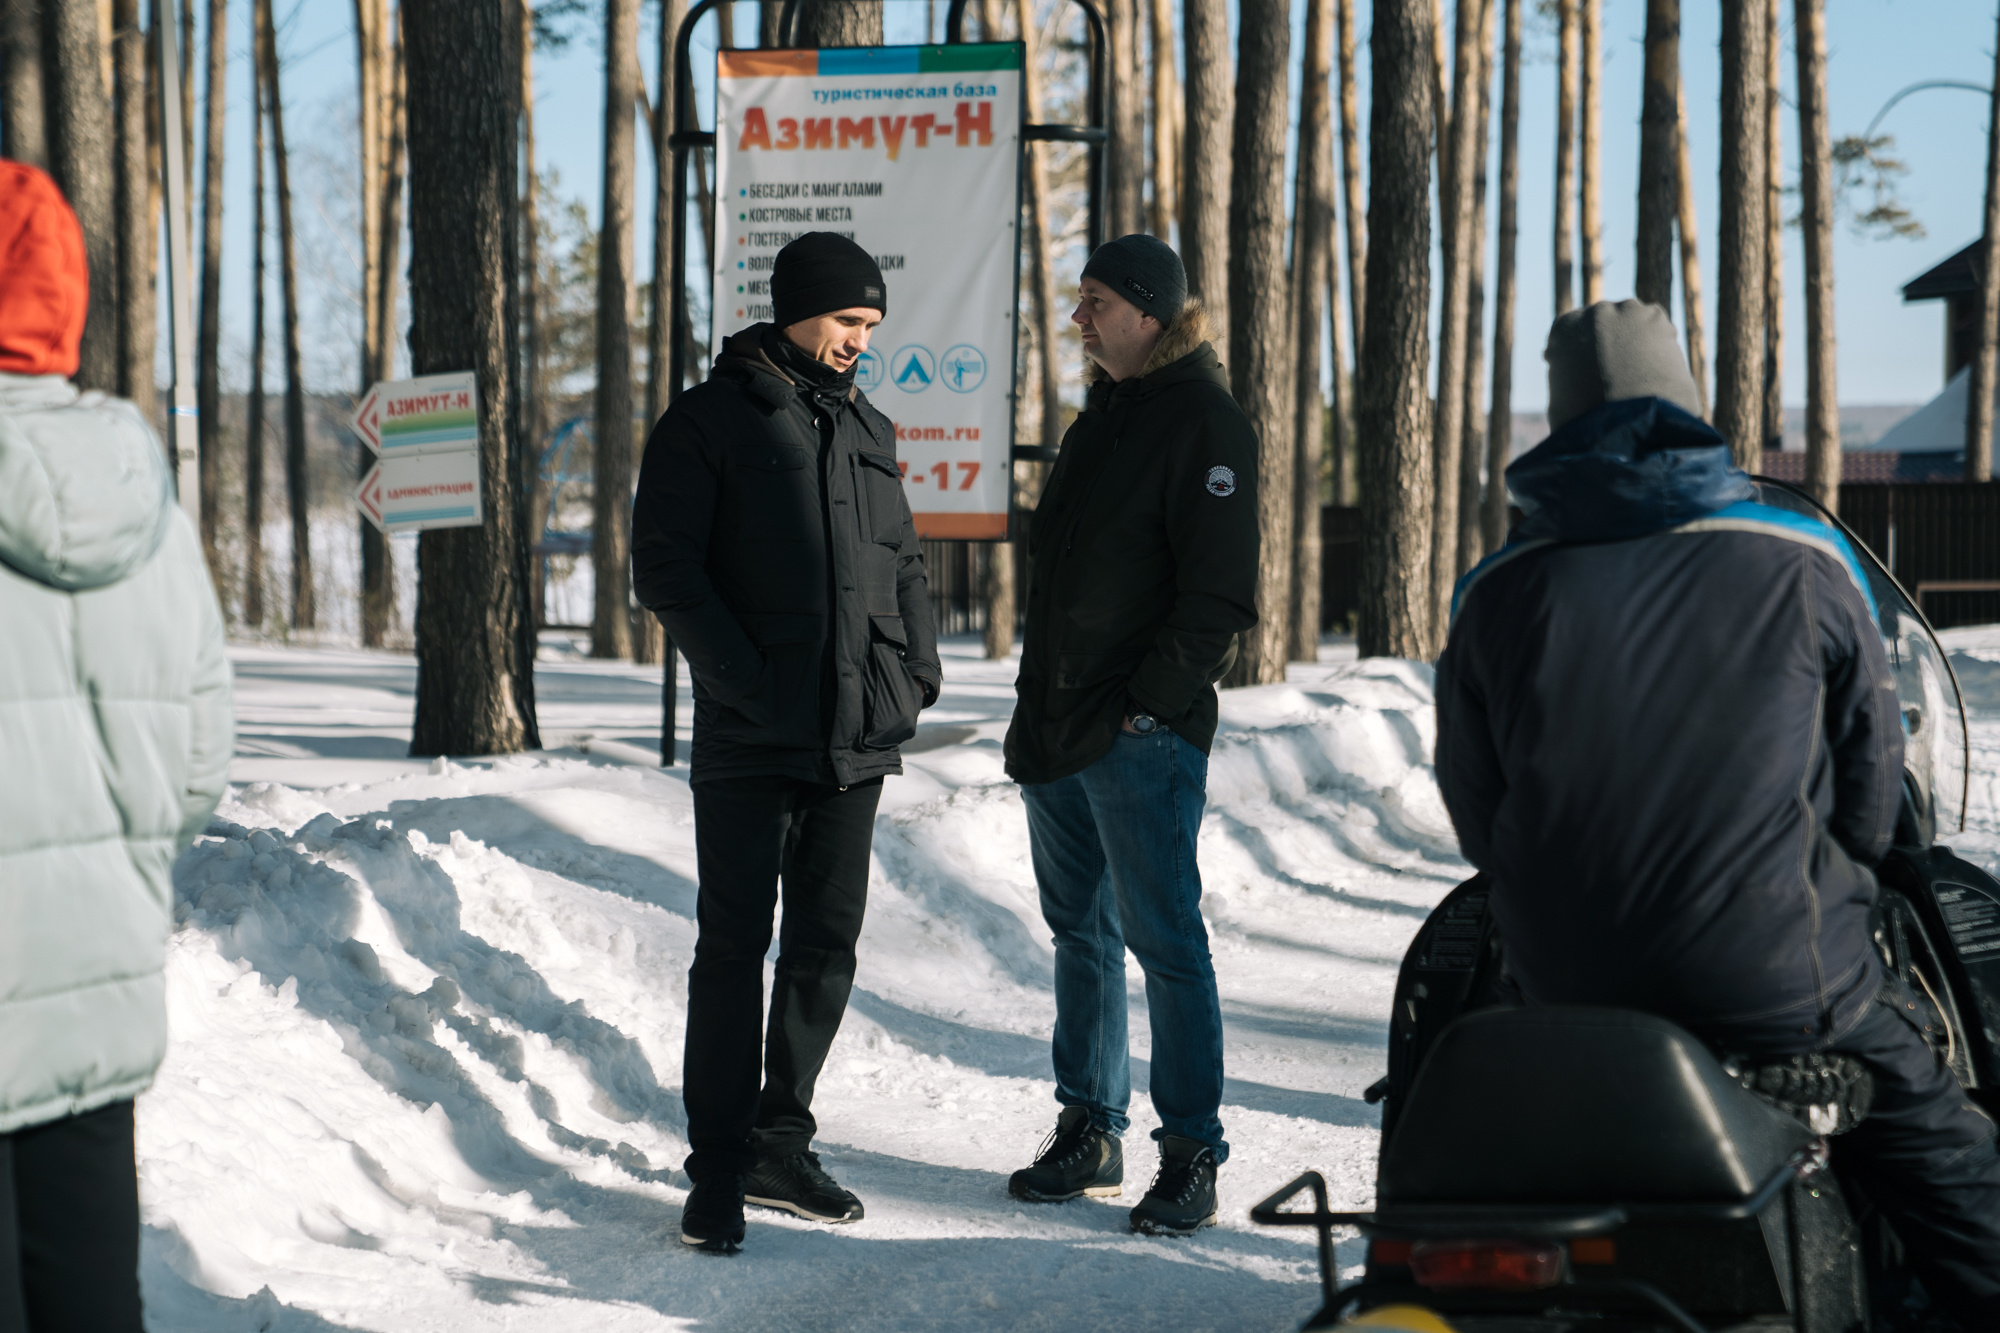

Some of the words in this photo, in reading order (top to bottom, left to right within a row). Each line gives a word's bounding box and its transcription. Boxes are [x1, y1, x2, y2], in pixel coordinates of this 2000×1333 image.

[812, 85, 948, 104] туристическая
[953, 81, 997, 98] база
[738, 101, 994, 162] Азимут-Н
[749, 183, 800, 200] БЕСЕДКИ
[802, 183, 809, 198] С
[811, 182, 883, 198] МАНГАЛАМИ
[749, 208, 813, 223] КОСТРОВЫЕ
[815, 207, 852, 222] МЕСТА
[387, 392, 469, 417] АЗИМУТ-Н
[893, 422, 980, 441] kom.ru
[387, 482, 474, 501] АДМИНИСТРАЦИЯ
